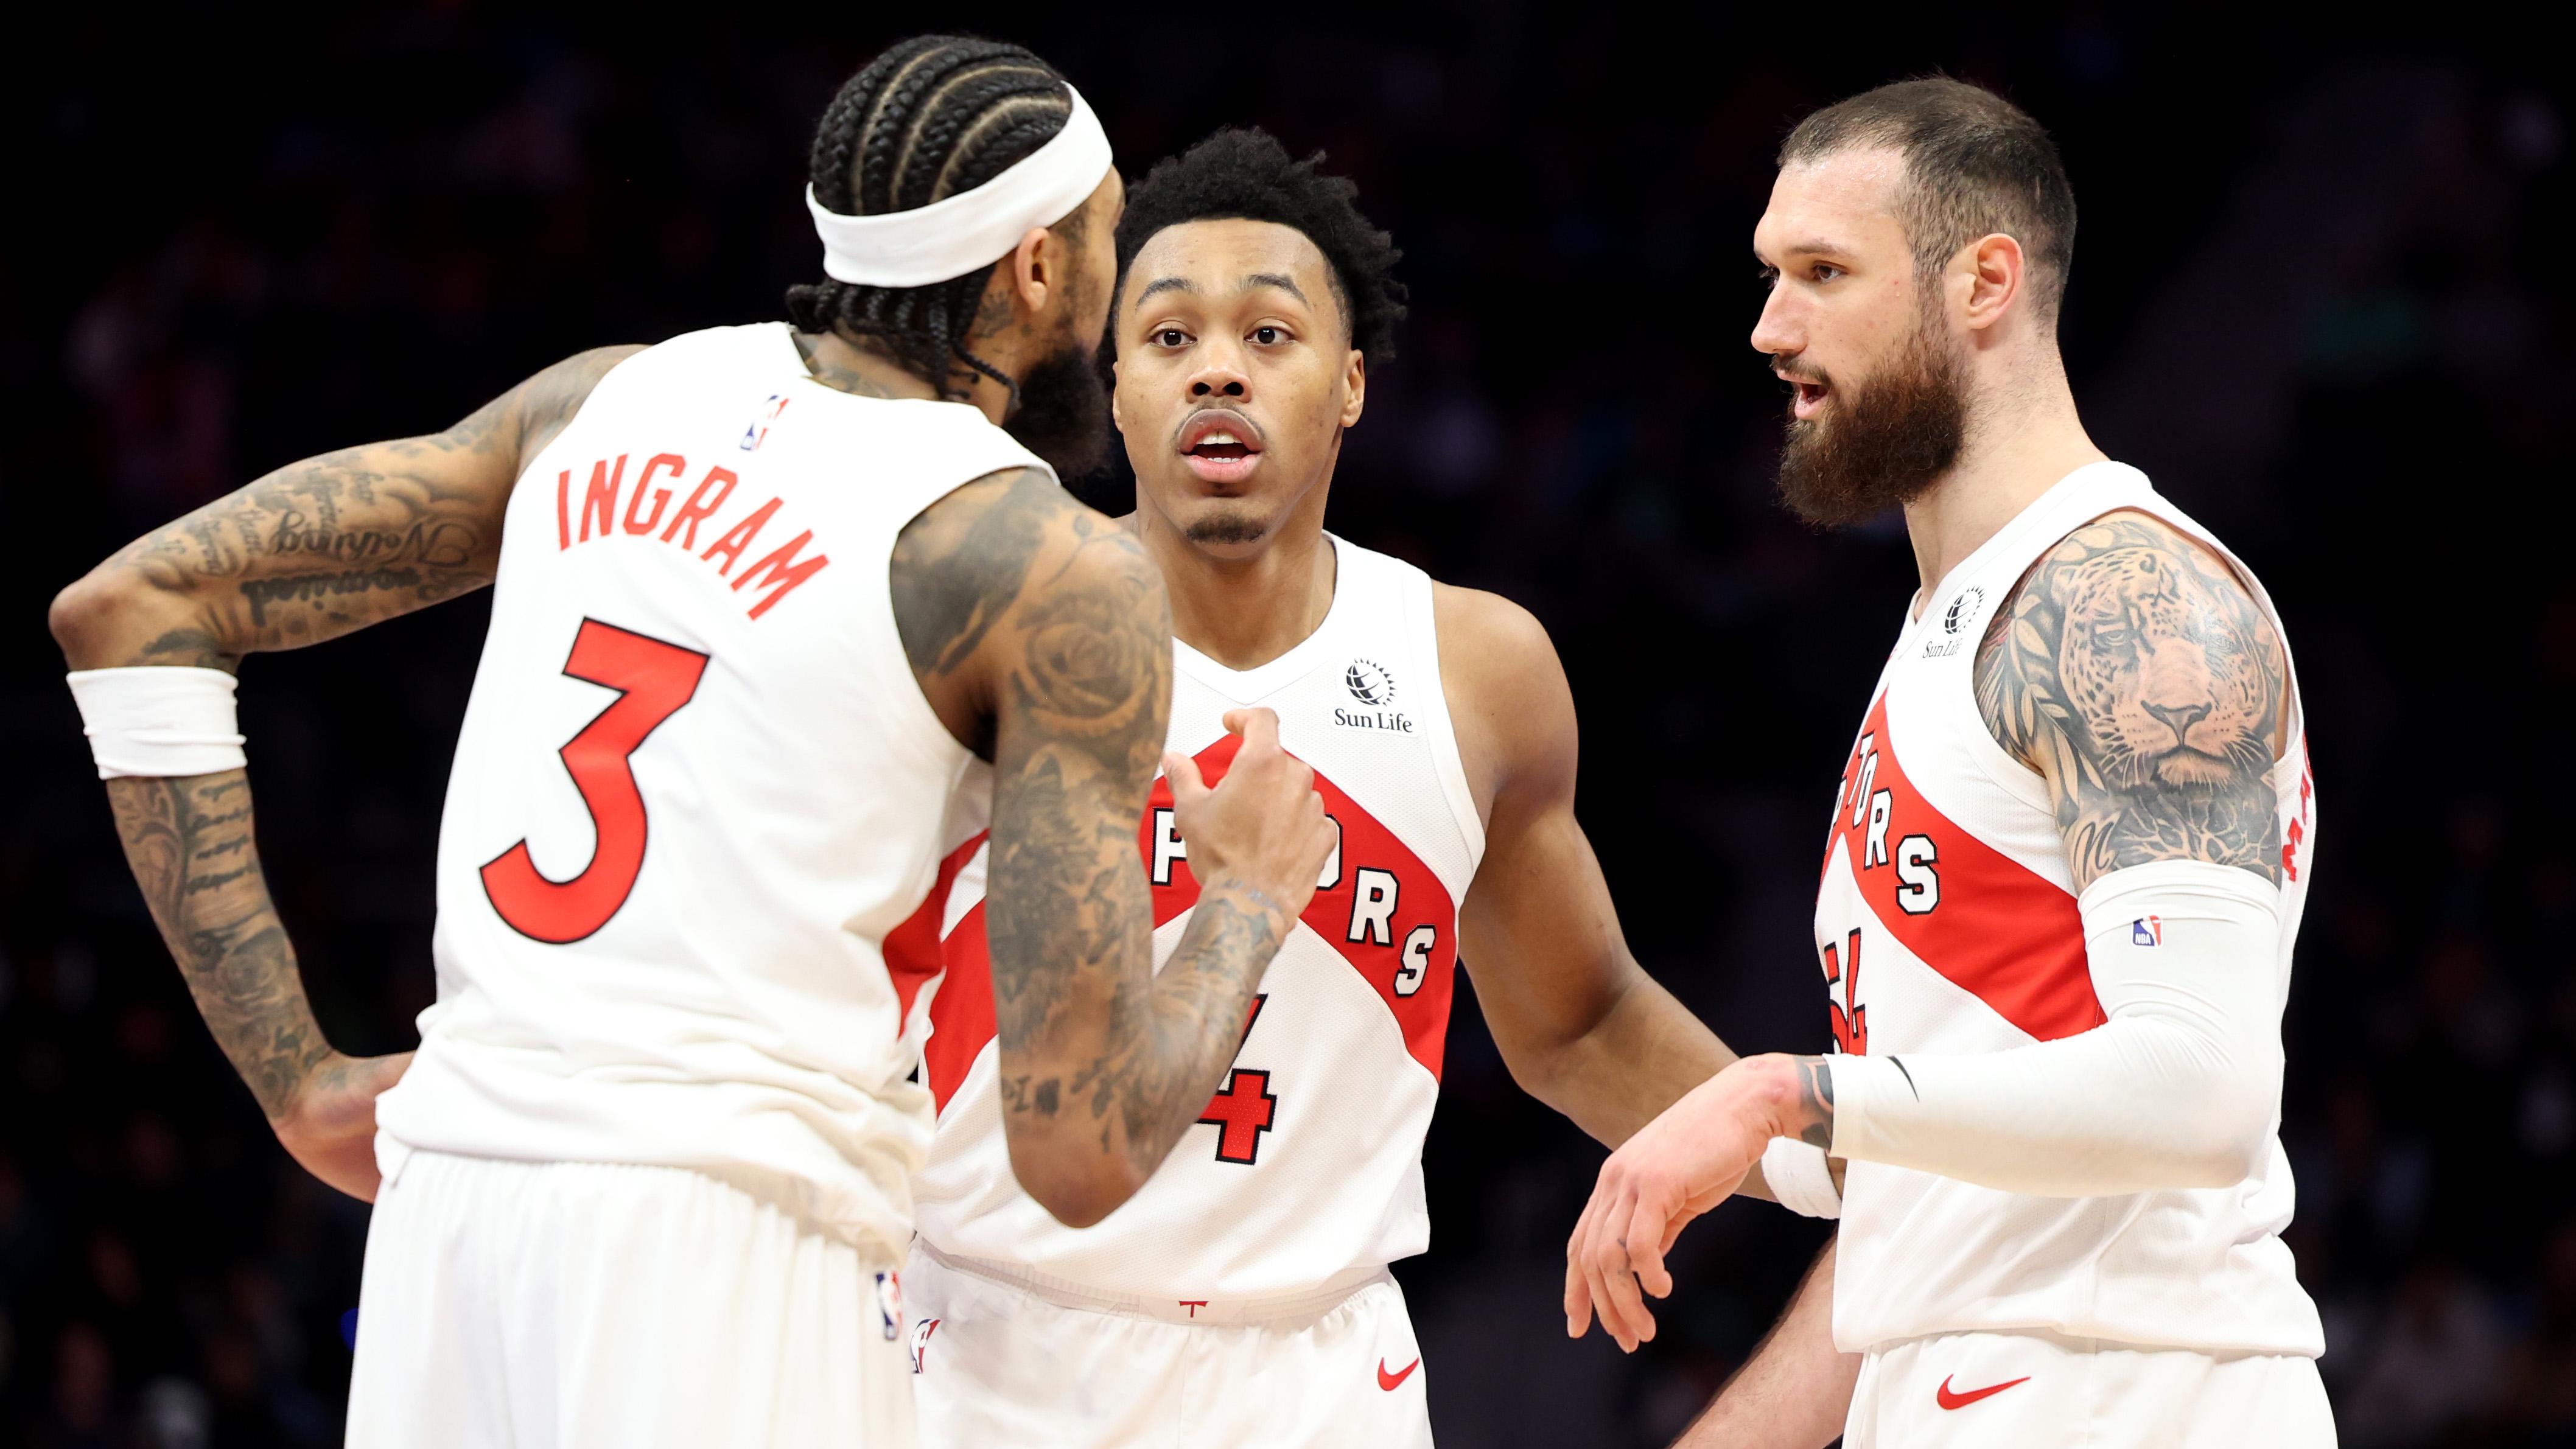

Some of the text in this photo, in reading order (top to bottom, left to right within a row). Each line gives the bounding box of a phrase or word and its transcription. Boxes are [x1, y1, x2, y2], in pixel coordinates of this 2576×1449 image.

[557, 453, 830, 621] INGRAM
[1922, 637, 1963, 658] Sun Lif
[1335, 708, 1413, 733] Sun Life
[479, 616, 714, 944] 3
[1826, 729, 1939, 915] PTORS
[2135, 933, 2151, 944] NBA
